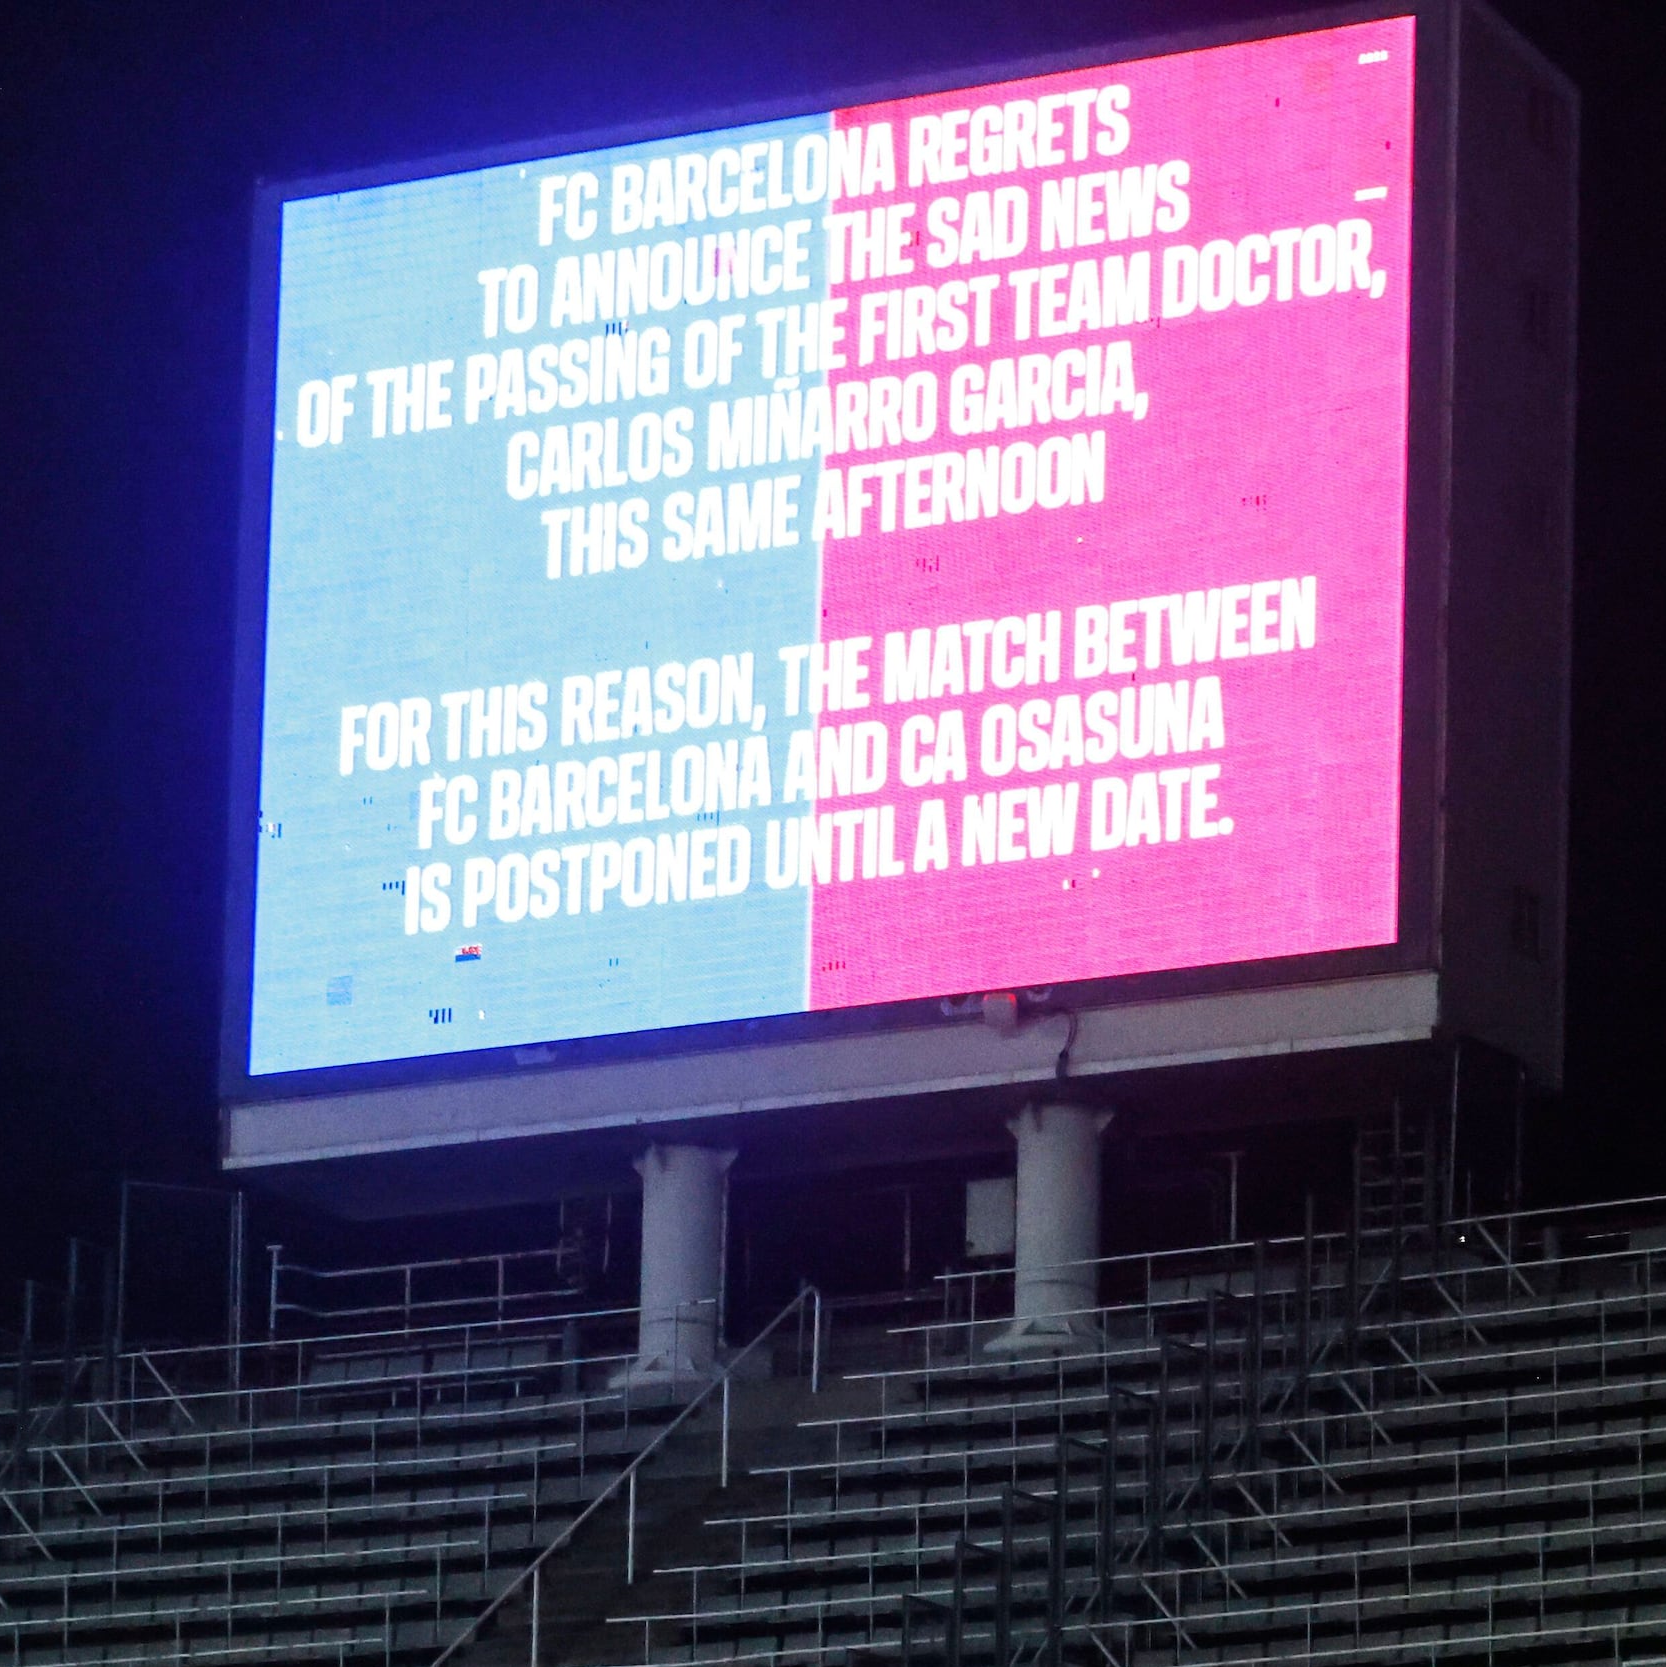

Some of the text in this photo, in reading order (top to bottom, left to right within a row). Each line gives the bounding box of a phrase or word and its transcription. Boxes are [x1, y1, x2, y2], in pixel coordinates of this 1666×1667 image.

[476, 159, 1191, 340] TO ANNOUNCE THE SAD NEWS
[537, 83, 1131, 248] FC BARCELONA REGRETS
[295, 217, 1387, 450] OF THE PASSING OF THE FIRST TEAM DOCTOR,
[505, 339, 1150, 502] CARLOS MIÑARRO GARCIA,
[539, 429, 1107, 581] THIS SAME AFTERNOON
[338, 574, 1318, 777] FOR THIS REASON, THE MATCH BETWEEN
[417, 675, 1226, 851] FC BARCELONA AND CA OSASUNA
[403, 762, 1235, 937] IS POSTPONED UNTIL A NEW DATE.
